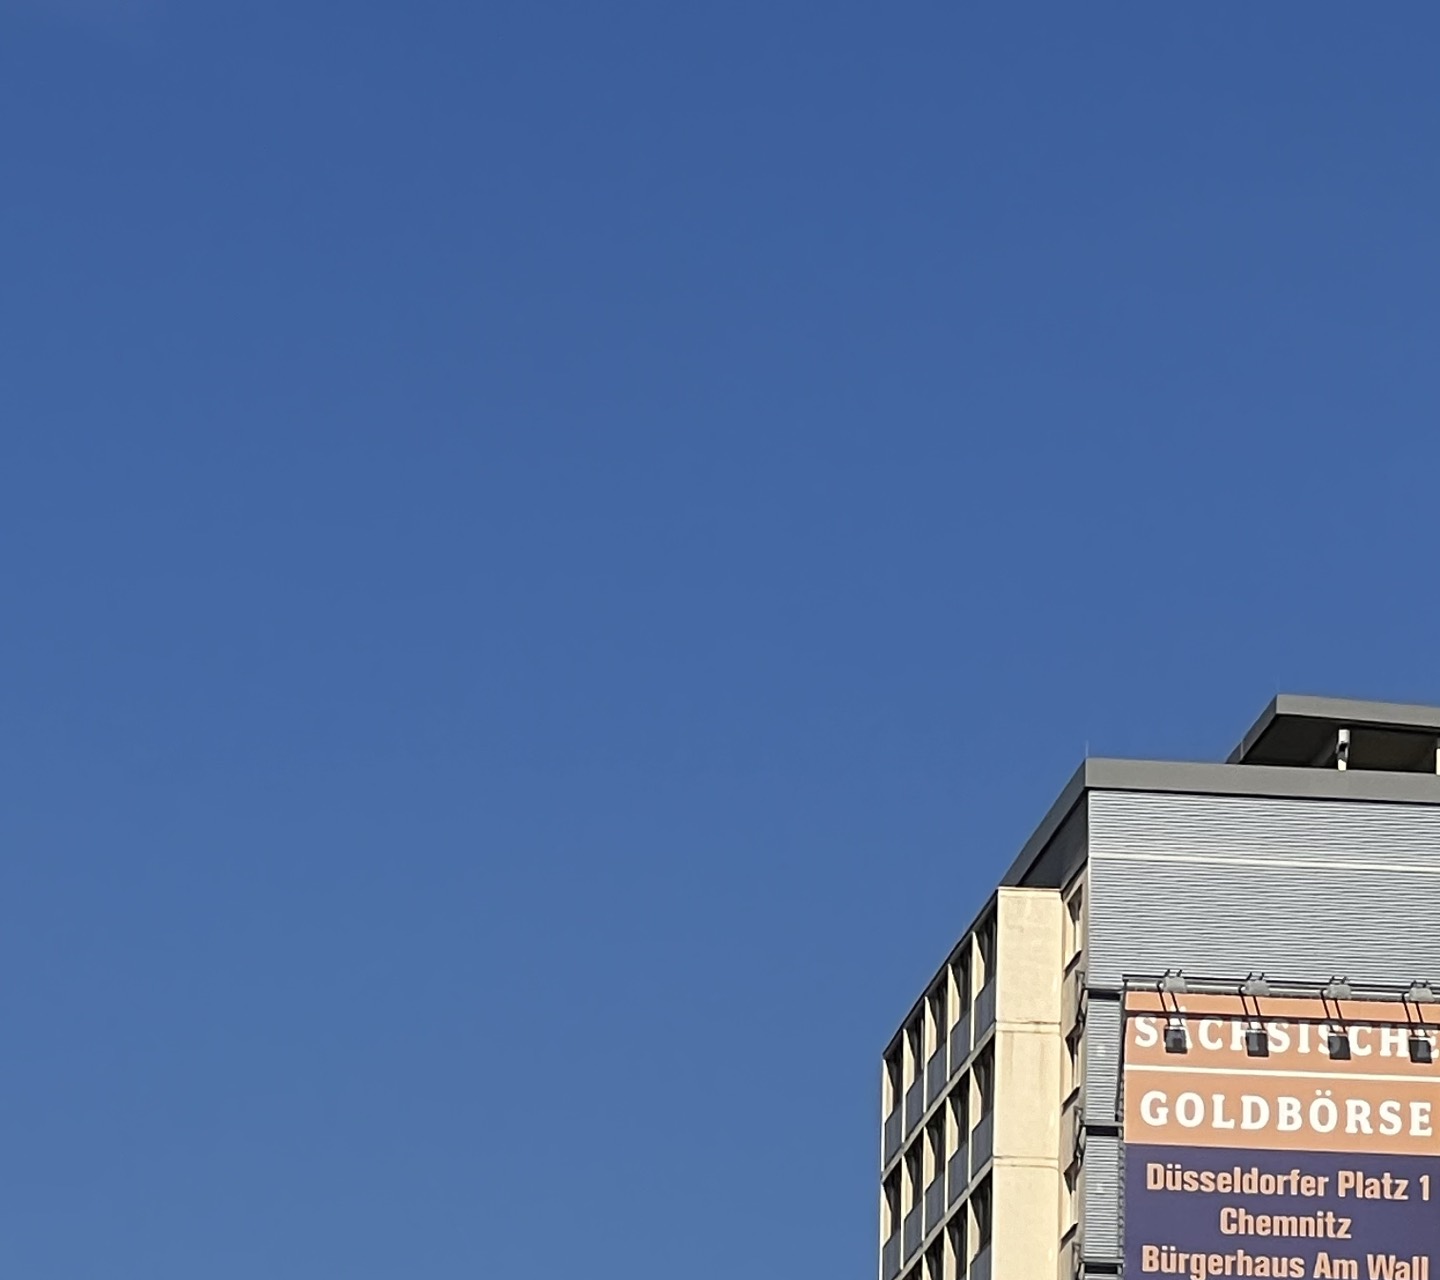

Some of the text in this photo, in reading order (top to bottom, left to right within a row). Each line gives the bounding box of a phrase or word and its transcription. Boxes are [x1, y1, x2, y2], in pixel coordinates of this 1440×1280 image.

[1140, 1089, 1433, 1137] GOLDBÖRSE
[1146, 1163, 1430, 1201] Düsseldorfer Platz 1
[1220, 1208, 1352, 1239] Chemnitz
[1313, 1252, 1358, 1280] Am
